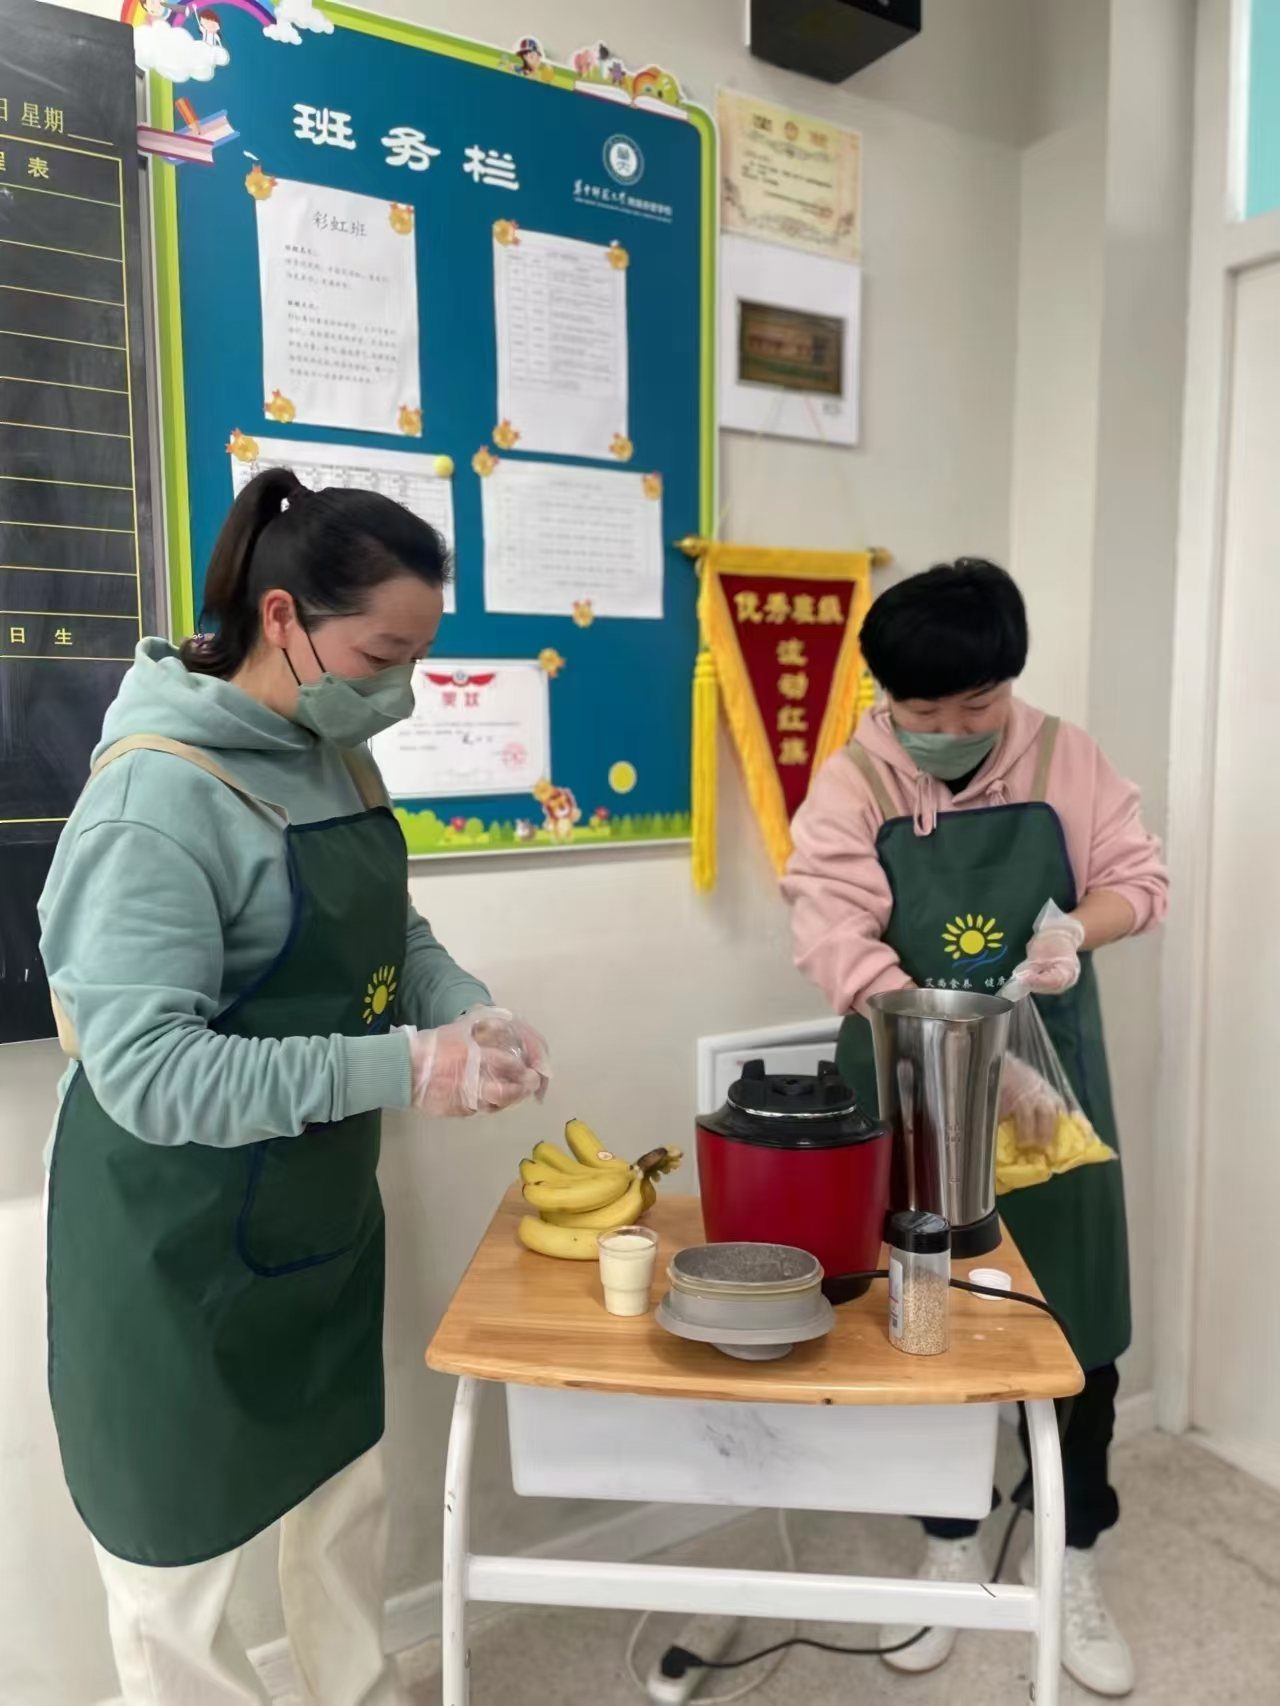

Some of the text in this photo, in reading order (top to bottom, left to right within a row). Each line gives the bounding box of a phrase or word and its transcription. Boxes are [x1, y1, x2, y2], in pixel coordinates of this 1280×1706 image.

[21, 101, 63, 134] 星期
[293, 103, 519, 190] 班务栏
[312, 210, 368, 237] 彩虹班
